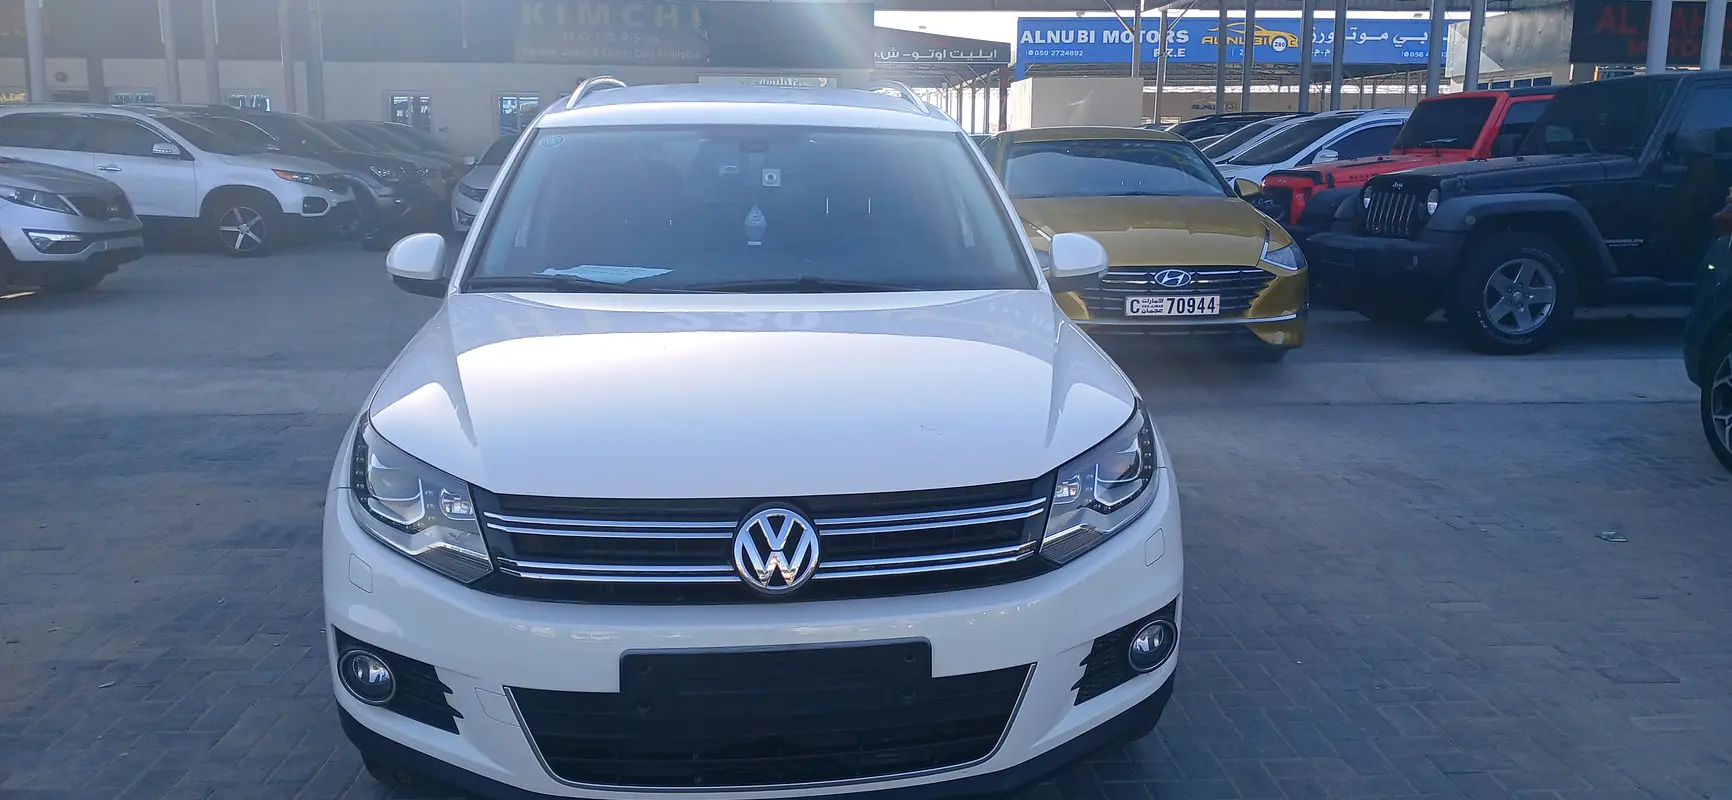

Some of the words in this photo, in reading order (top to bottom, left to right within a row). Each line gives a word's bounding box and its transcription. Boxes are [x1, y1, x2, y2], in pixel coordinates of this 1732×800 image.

[521, 2, 702, 28] KIMCHI
[1594, 4, 1640, 34] AL
[563, 31, 640, 43] MOTORS
[1020, 30, 1095, 43] ALNUBI
[1102, 30, 1189, 43] MOTORS
[657, 49, 701, 59] Available
[1130, 299, 1141, 314] C
[1166, 297, 1216, 314] 70944
[737, 510, 816, 588] VW
